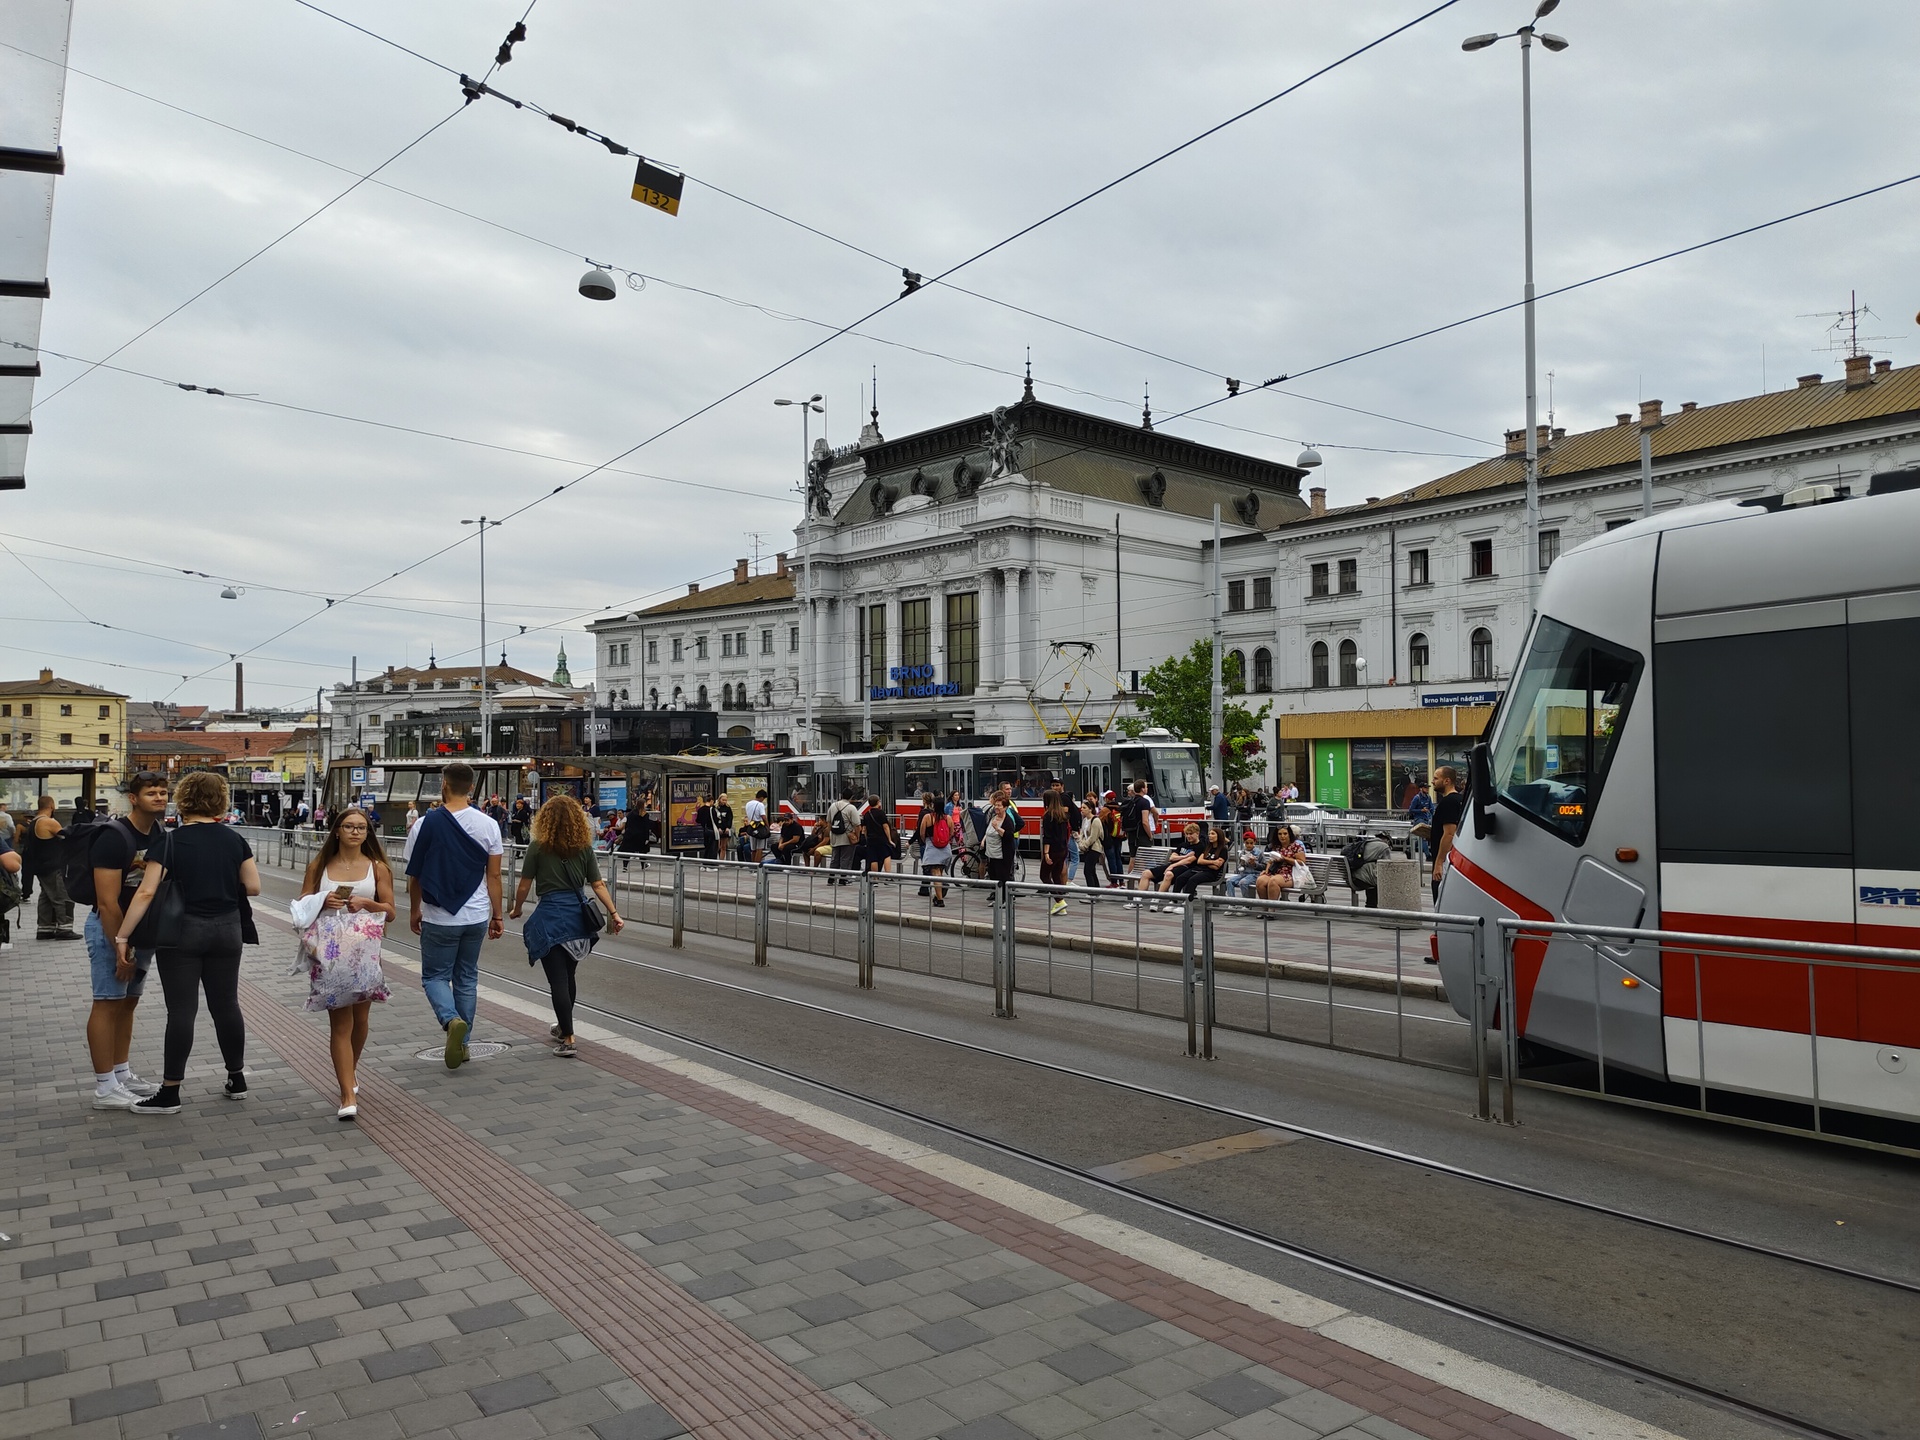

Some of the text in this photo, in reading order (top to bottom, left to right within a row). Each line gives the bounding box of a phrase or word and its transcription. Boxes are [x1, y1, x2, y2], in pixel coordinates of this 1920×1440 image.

[642, 188, 670, 211] 132
[890, 664, 933, 680] BRNO
[908, 681, 960, 697] nádraží
[1461, 694, 1485, 702] nádraží
[1156, 751, 1162, 760] 8
[673, 781, 709, 792] LETNÍ KINO
